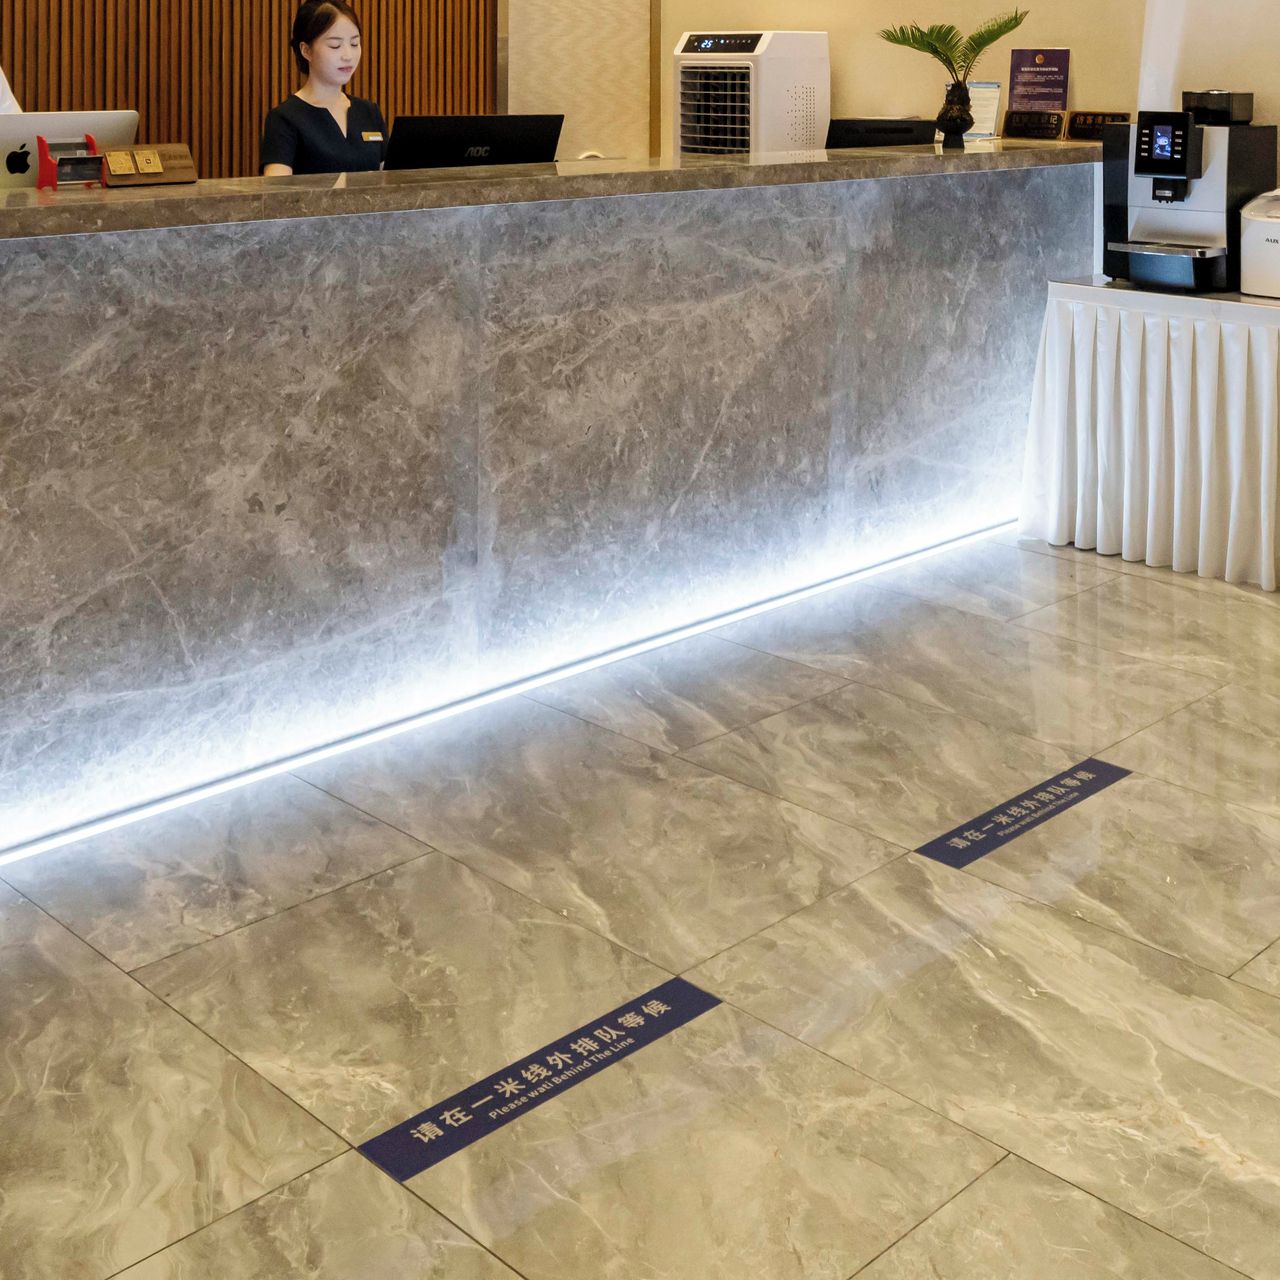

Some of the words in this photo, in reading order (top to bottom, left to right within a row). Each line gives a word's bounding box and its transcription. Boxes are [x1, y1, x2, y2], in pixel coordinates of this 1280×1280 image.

[701, 39, 713, 48] 25
[464, 146, 490, 157] AOC
[946, 770, 1097, 849] 请在一米线外排队等候
[410, 999, 672, 1143] 请在一米线外排队等候
[488, 1096, 529, 1119] Please
[528, 1081, 554, 1098] wati
[551, 1060, 592, 1085] Behind
[588, 1049, 613, 1063] The
[609, 1037, 635, 1052] Line
